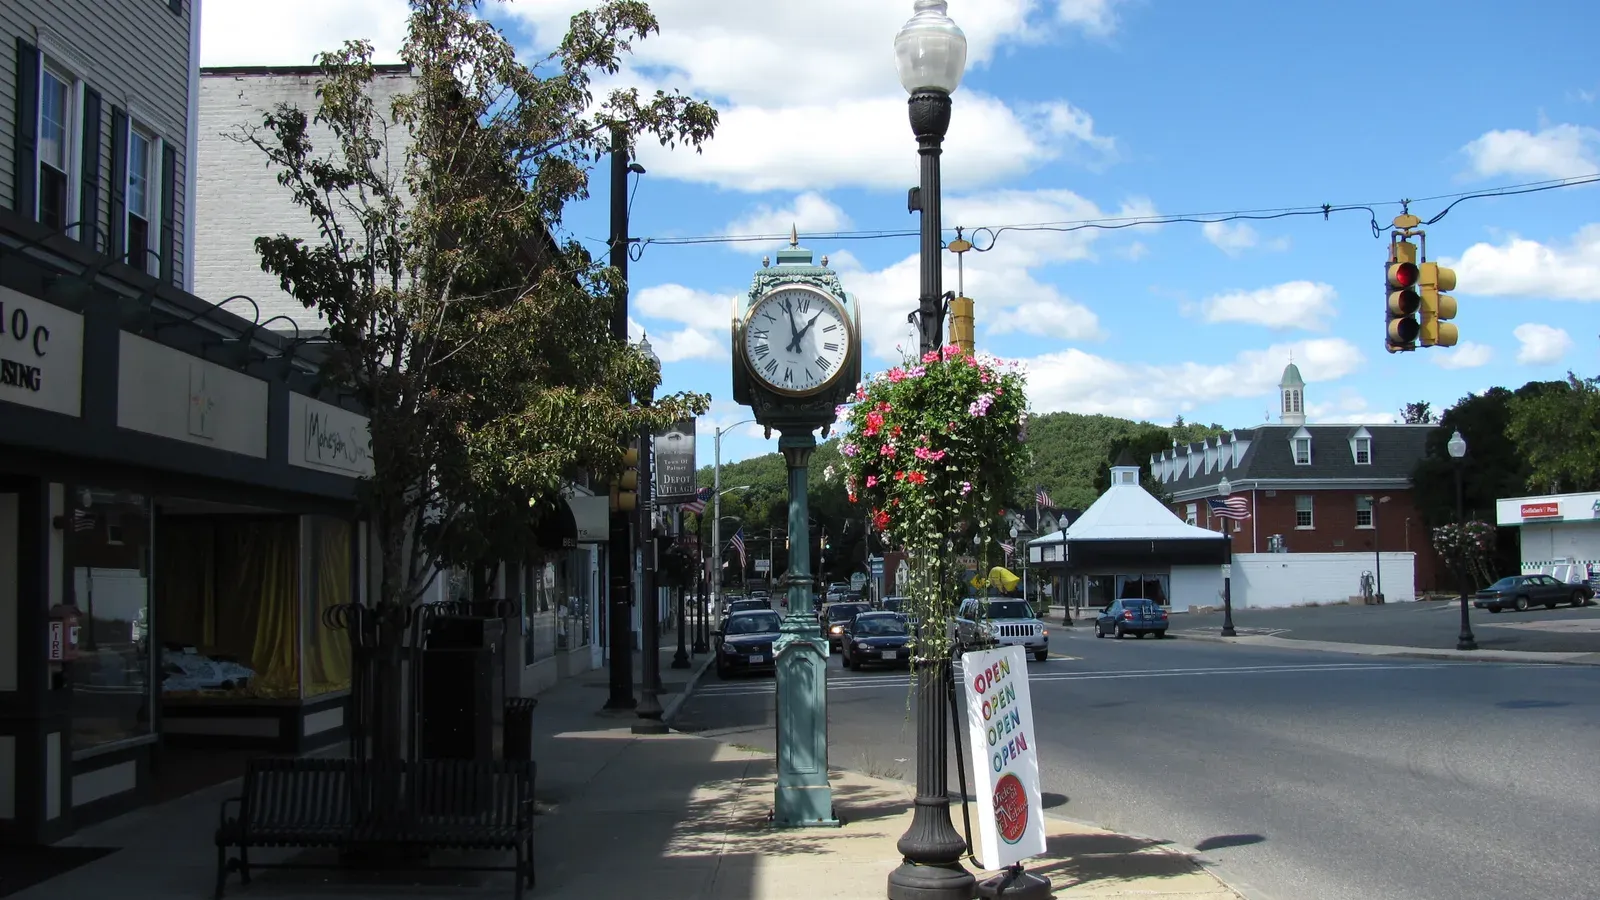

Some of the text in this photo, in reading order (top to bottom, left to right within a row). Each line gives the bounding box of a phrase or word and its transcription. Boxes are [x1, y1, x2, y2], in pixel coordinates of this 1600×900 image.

[795, 298, 811, 314] XII
[762, 311, 777, 324] X
[822, 324, 838, 333] II
[823, 342, 839, 352] III
[664, 474, 691, 484] DEPOT
[660, 484, 694, 495] VILLAGE
[52, 623, 60, 659] FIRE
[973, 656, 1011, 695] OPEN
[982, 682, 1016, 721] OPEN
[987, 706, 1021, 747] OPEN
[993, 731, 1028, 773] OPEN
